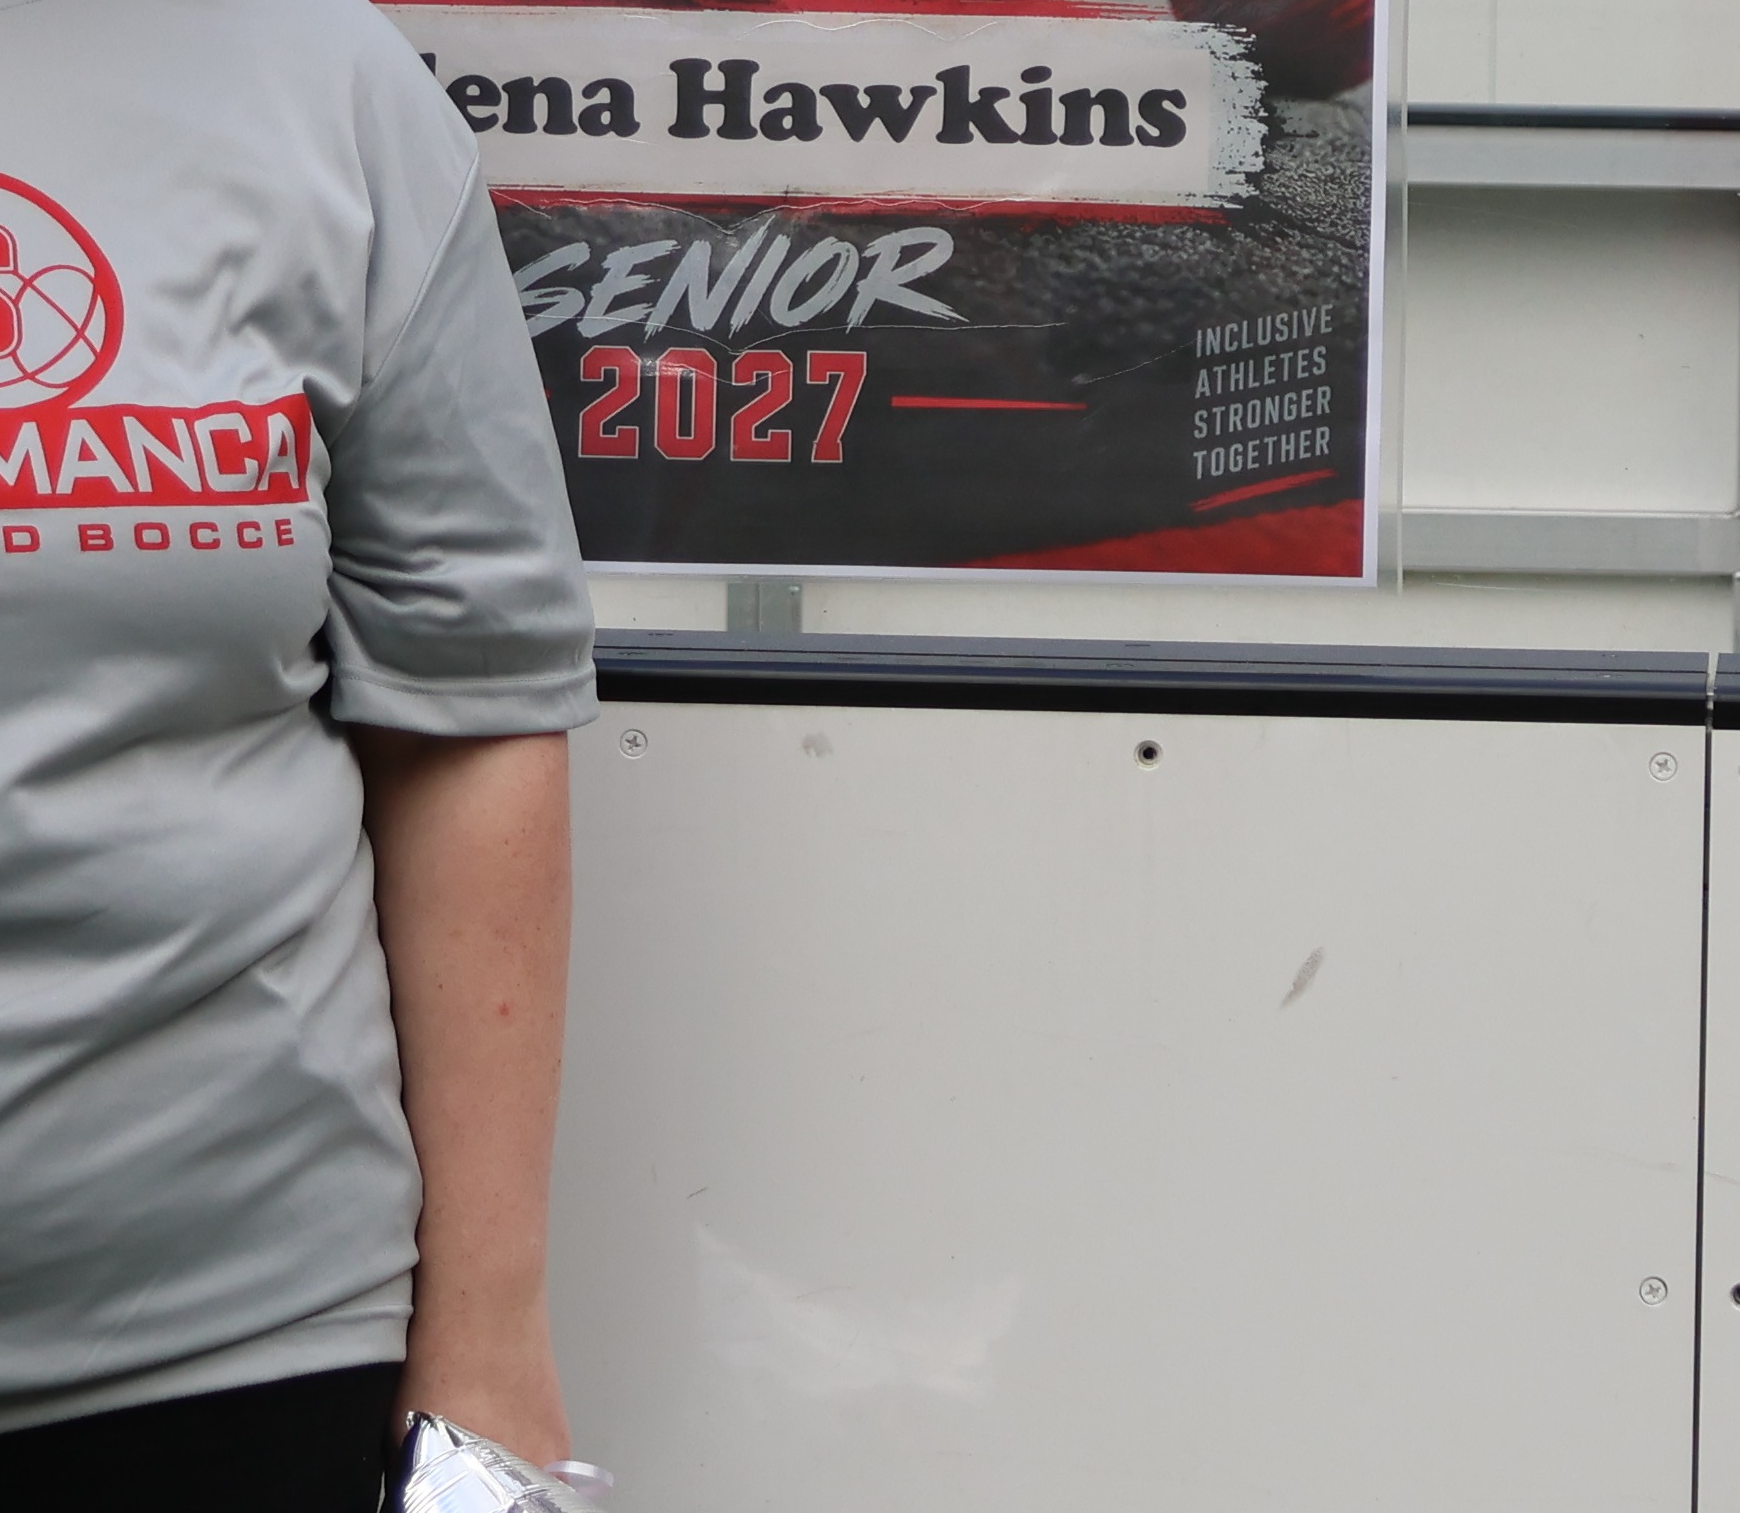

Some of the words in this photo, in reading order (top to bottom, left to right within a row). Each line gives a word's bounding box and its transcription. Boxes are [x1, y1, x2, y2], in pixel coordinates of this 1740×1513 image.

[419, 52, 641, 138] ena
[667, 57, 1188, 148] Hawkins
[510, 214, 969, 343] SENIOR
[1196, 303, 1334, 358] INCLUSIVE
[1194, 345, 1327, 399] ATHLETES
[577, 344, 868, 464] 2027
[1193, 385, 1332, 439] STRONGER
[1192, 426, 1330, 480] TOGETHER
[77, 517, 295, 555] BOCCE
